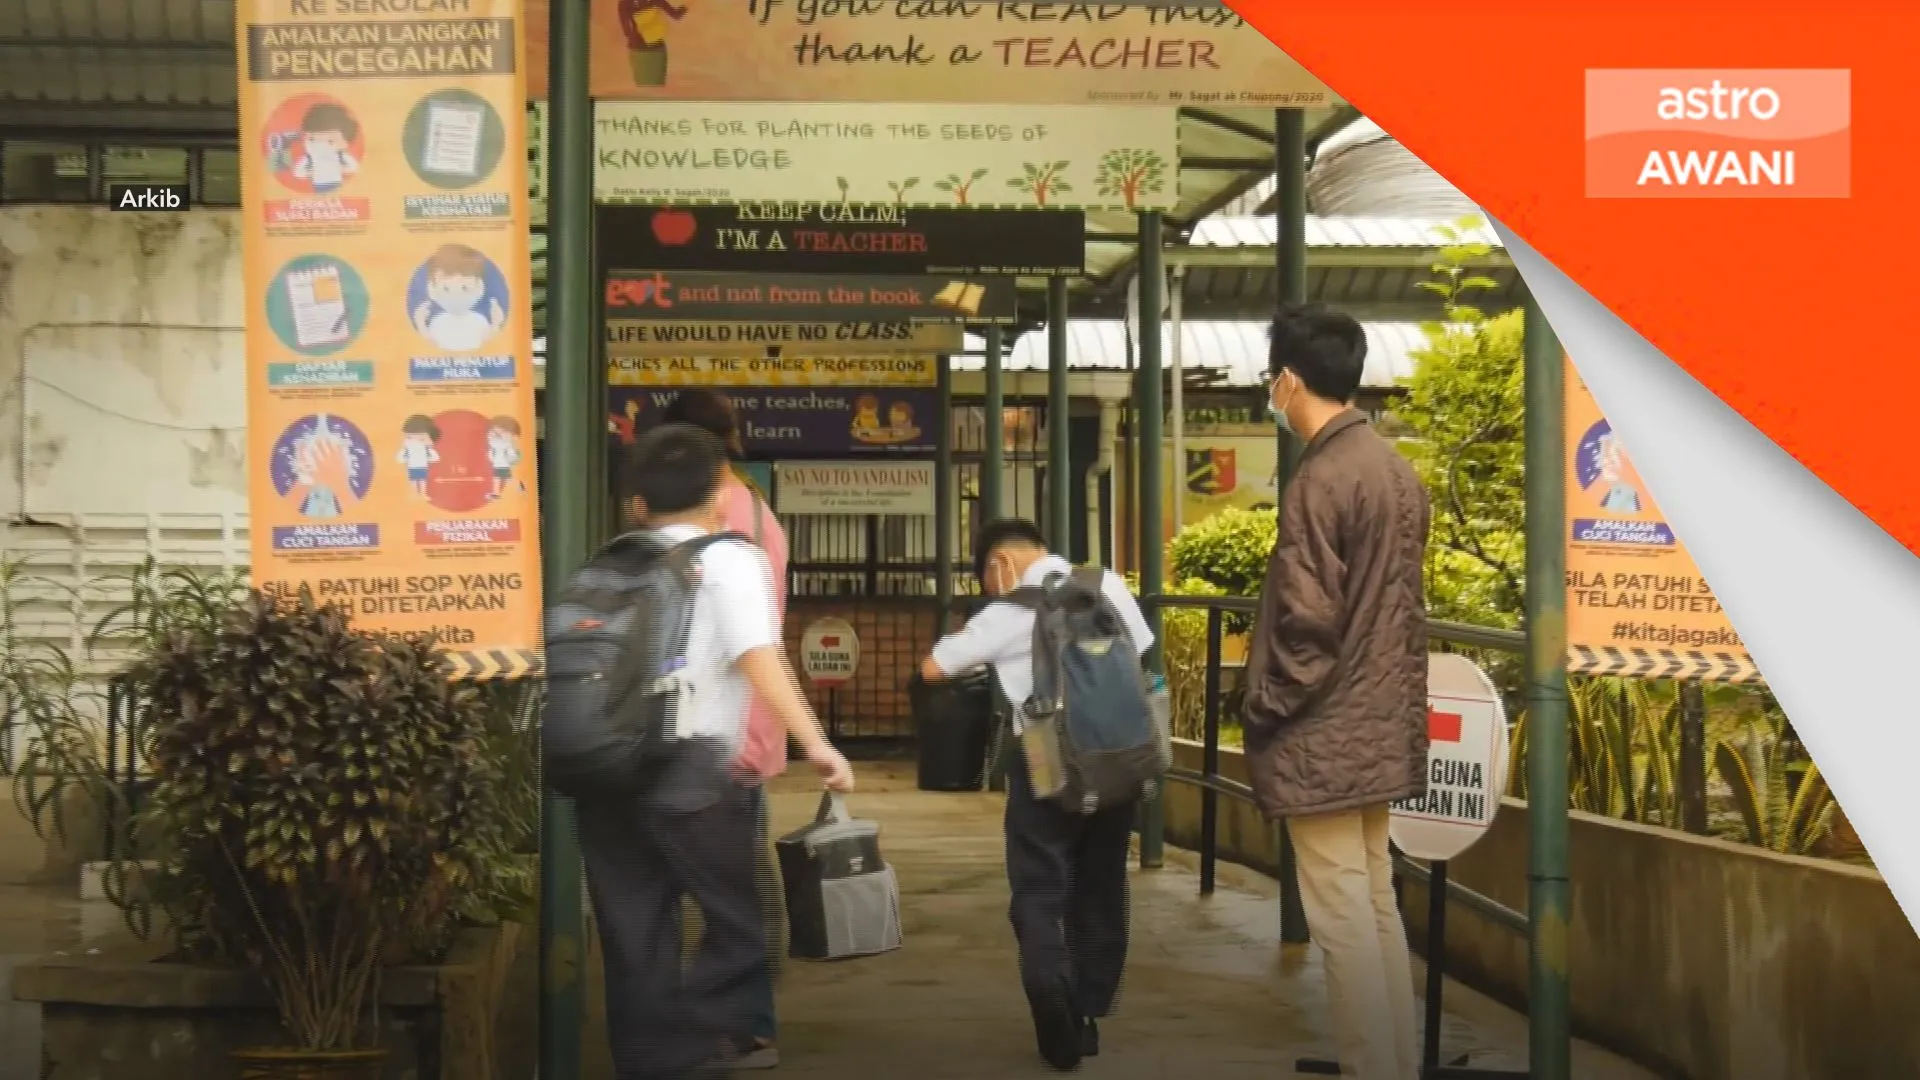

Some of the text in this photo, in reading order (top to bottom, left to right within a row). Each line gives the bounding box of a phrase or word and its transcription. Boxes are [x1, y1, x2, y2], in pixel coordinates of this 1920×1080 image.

[797, 0, 884, 24] you
[896, 0, 982, 18] can
[997, 2, 1127, 22] READ
[262, 20, 501, 47] AMALKAN LANGKAH
[270, 45, 494, 75] PENCEGAHAN
[794, 32, 1221, 69] thank a TEACHER
[597, 116, 1049, 141] THANKS FOR PLANTING THE SEEDS OF
[597, 147, 792, 171] KNOWLEDGE
[735, 203, 813, 223] KEEP
[715, 228, 928, 253] I'M A TEACHER
[679, 285, 720, 303] and
[727, 285, 762, 303] not
[768, 285, 820, 304] from
[826, 285, 862, 304] the
[870, 286, 923, 306] book
[608, 326, 648, 342] LIFE
[653, 325, 732, 342] WOULD
[737, 324, 791, 342] HAVE
[799, 323, 828, 341] NO
[668, 357, 701, 372] ALL
[708, 357, 740, 371] THE
[749, 357, 805, 372] OTHER
[813, 358, 926, 373] PROFESSIONS
[766, 389, 850, 412] teaches,
[747, 421, 802, 440] learn
[783, 468, 929, 486] SAY NO TO VANDALISM
[1581, 530, 1613, 541] CUCI
[319, 576, 400, 596] PATUHI
[406, 574, 452, 593] SOP
[458, 572, 523, 591] YANG
[1613, 572, 1692, 594] PATUHI
[362, 592, 505, 614] DITETAPKAN
[1575, 590, 1646, 609] TELAH
[1430, 758, 1483, 789] GUNA
[1457, 792, 1485, 820] INI
